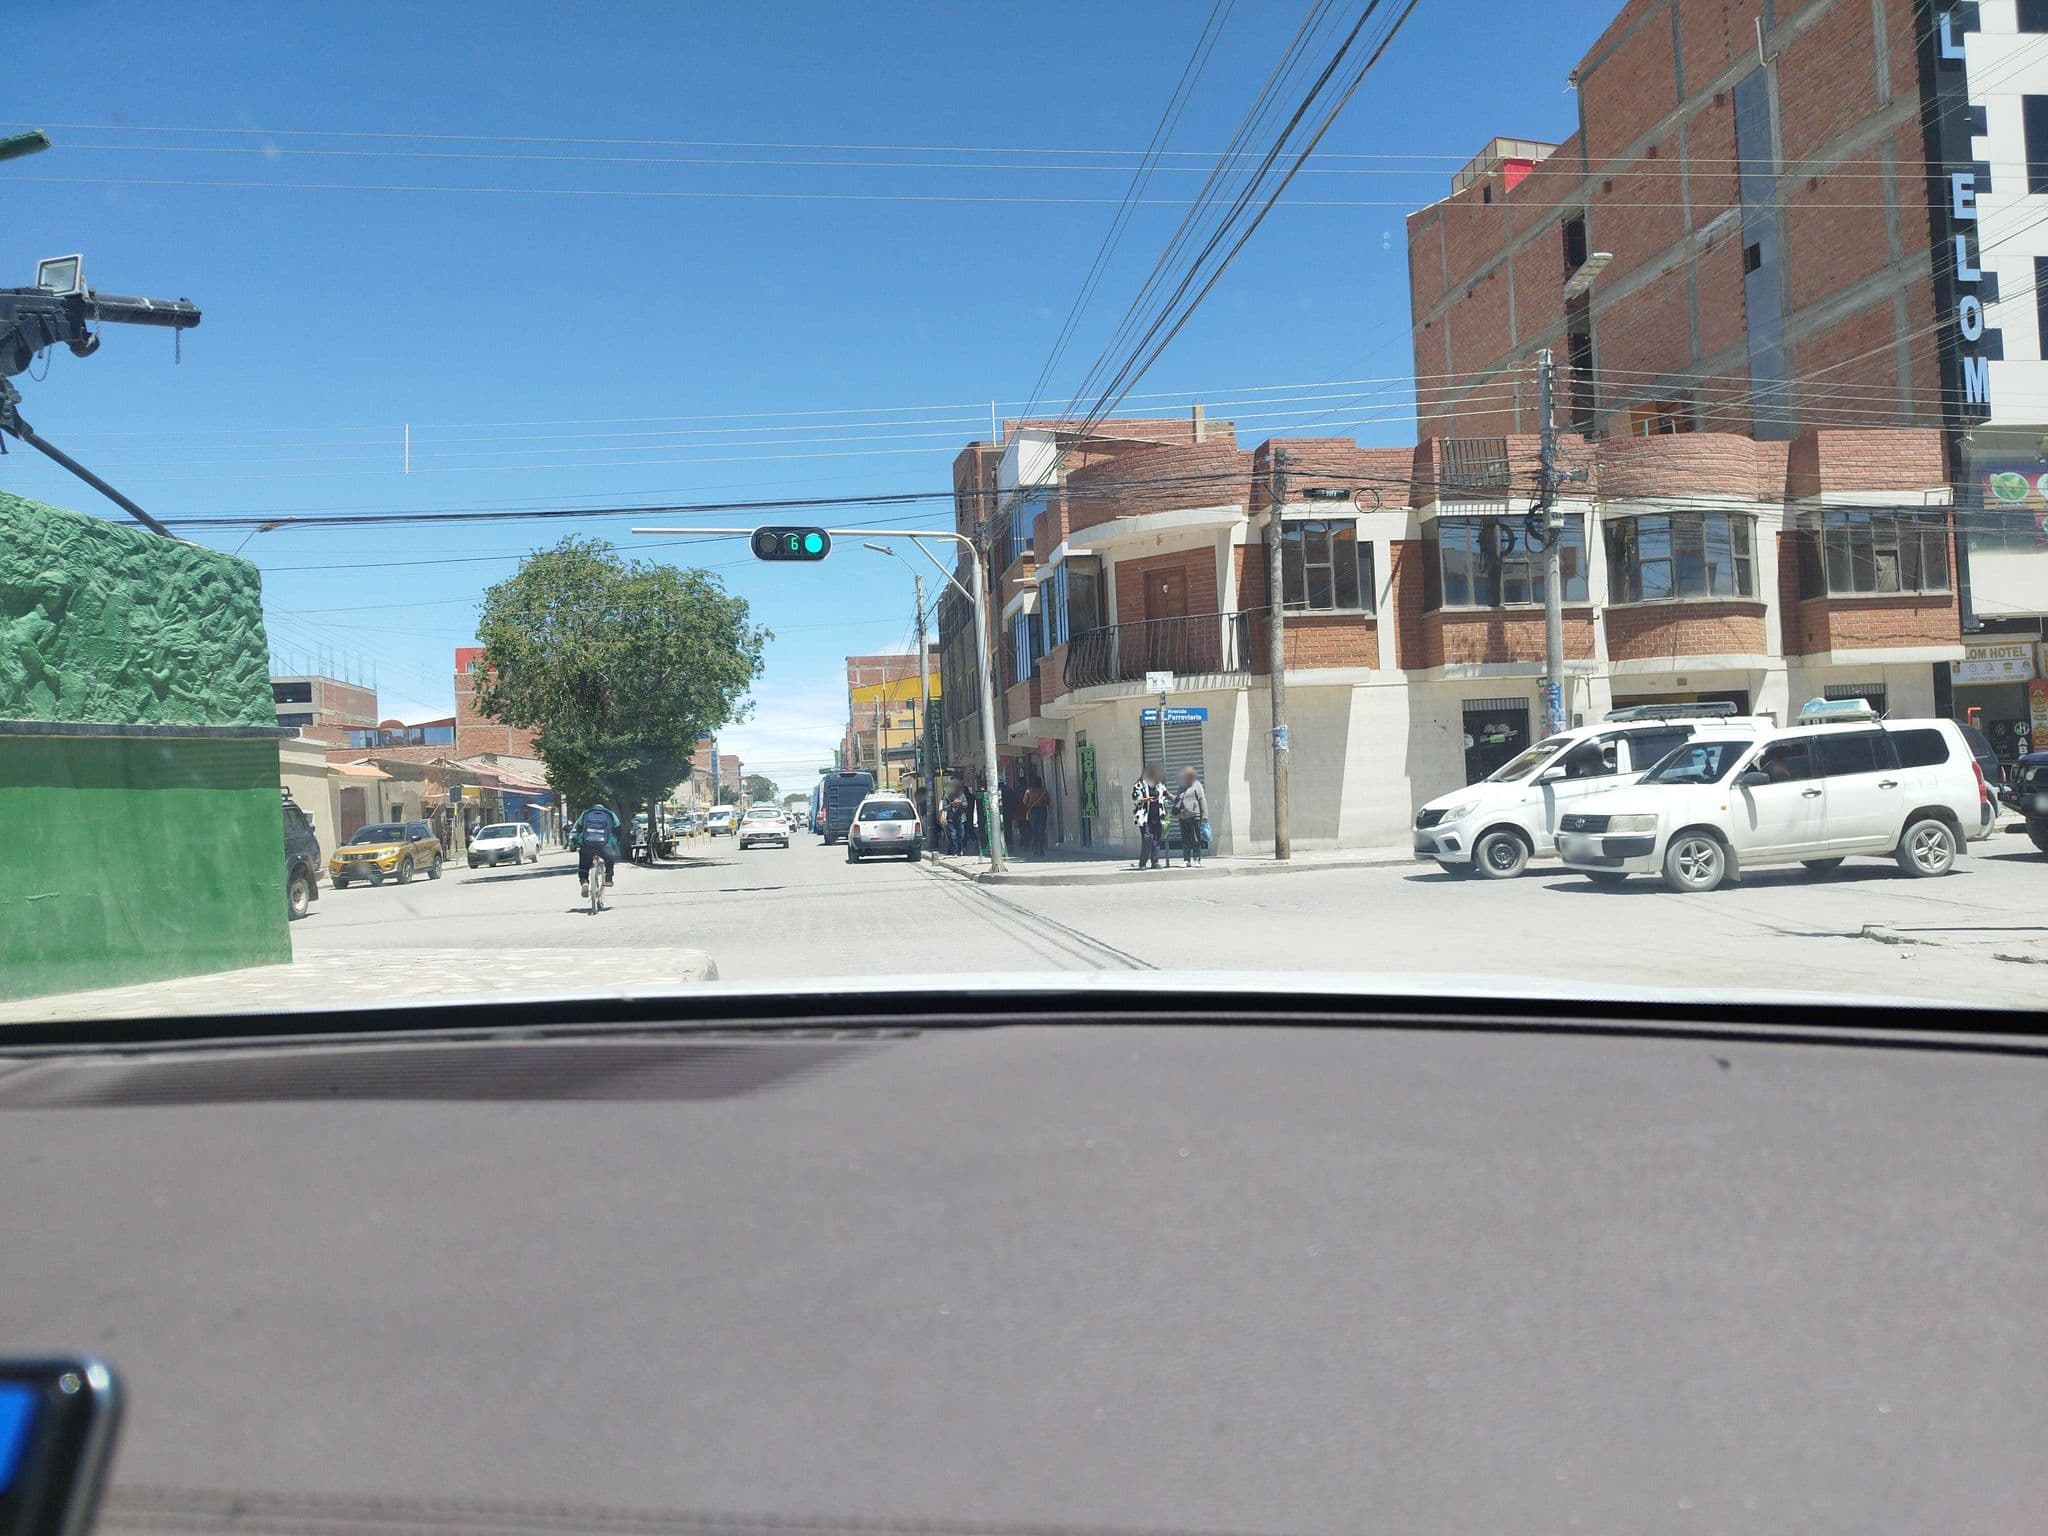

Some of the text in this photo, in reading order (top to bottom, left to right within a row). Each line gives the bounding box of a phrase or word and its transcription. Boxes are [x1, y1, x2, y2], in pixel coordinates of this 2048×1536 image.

[1952, 172, 1990, 404] ELOM
[791, 537, 799, 550] 6
[1990, 646, 2026, 659] HOTEL
